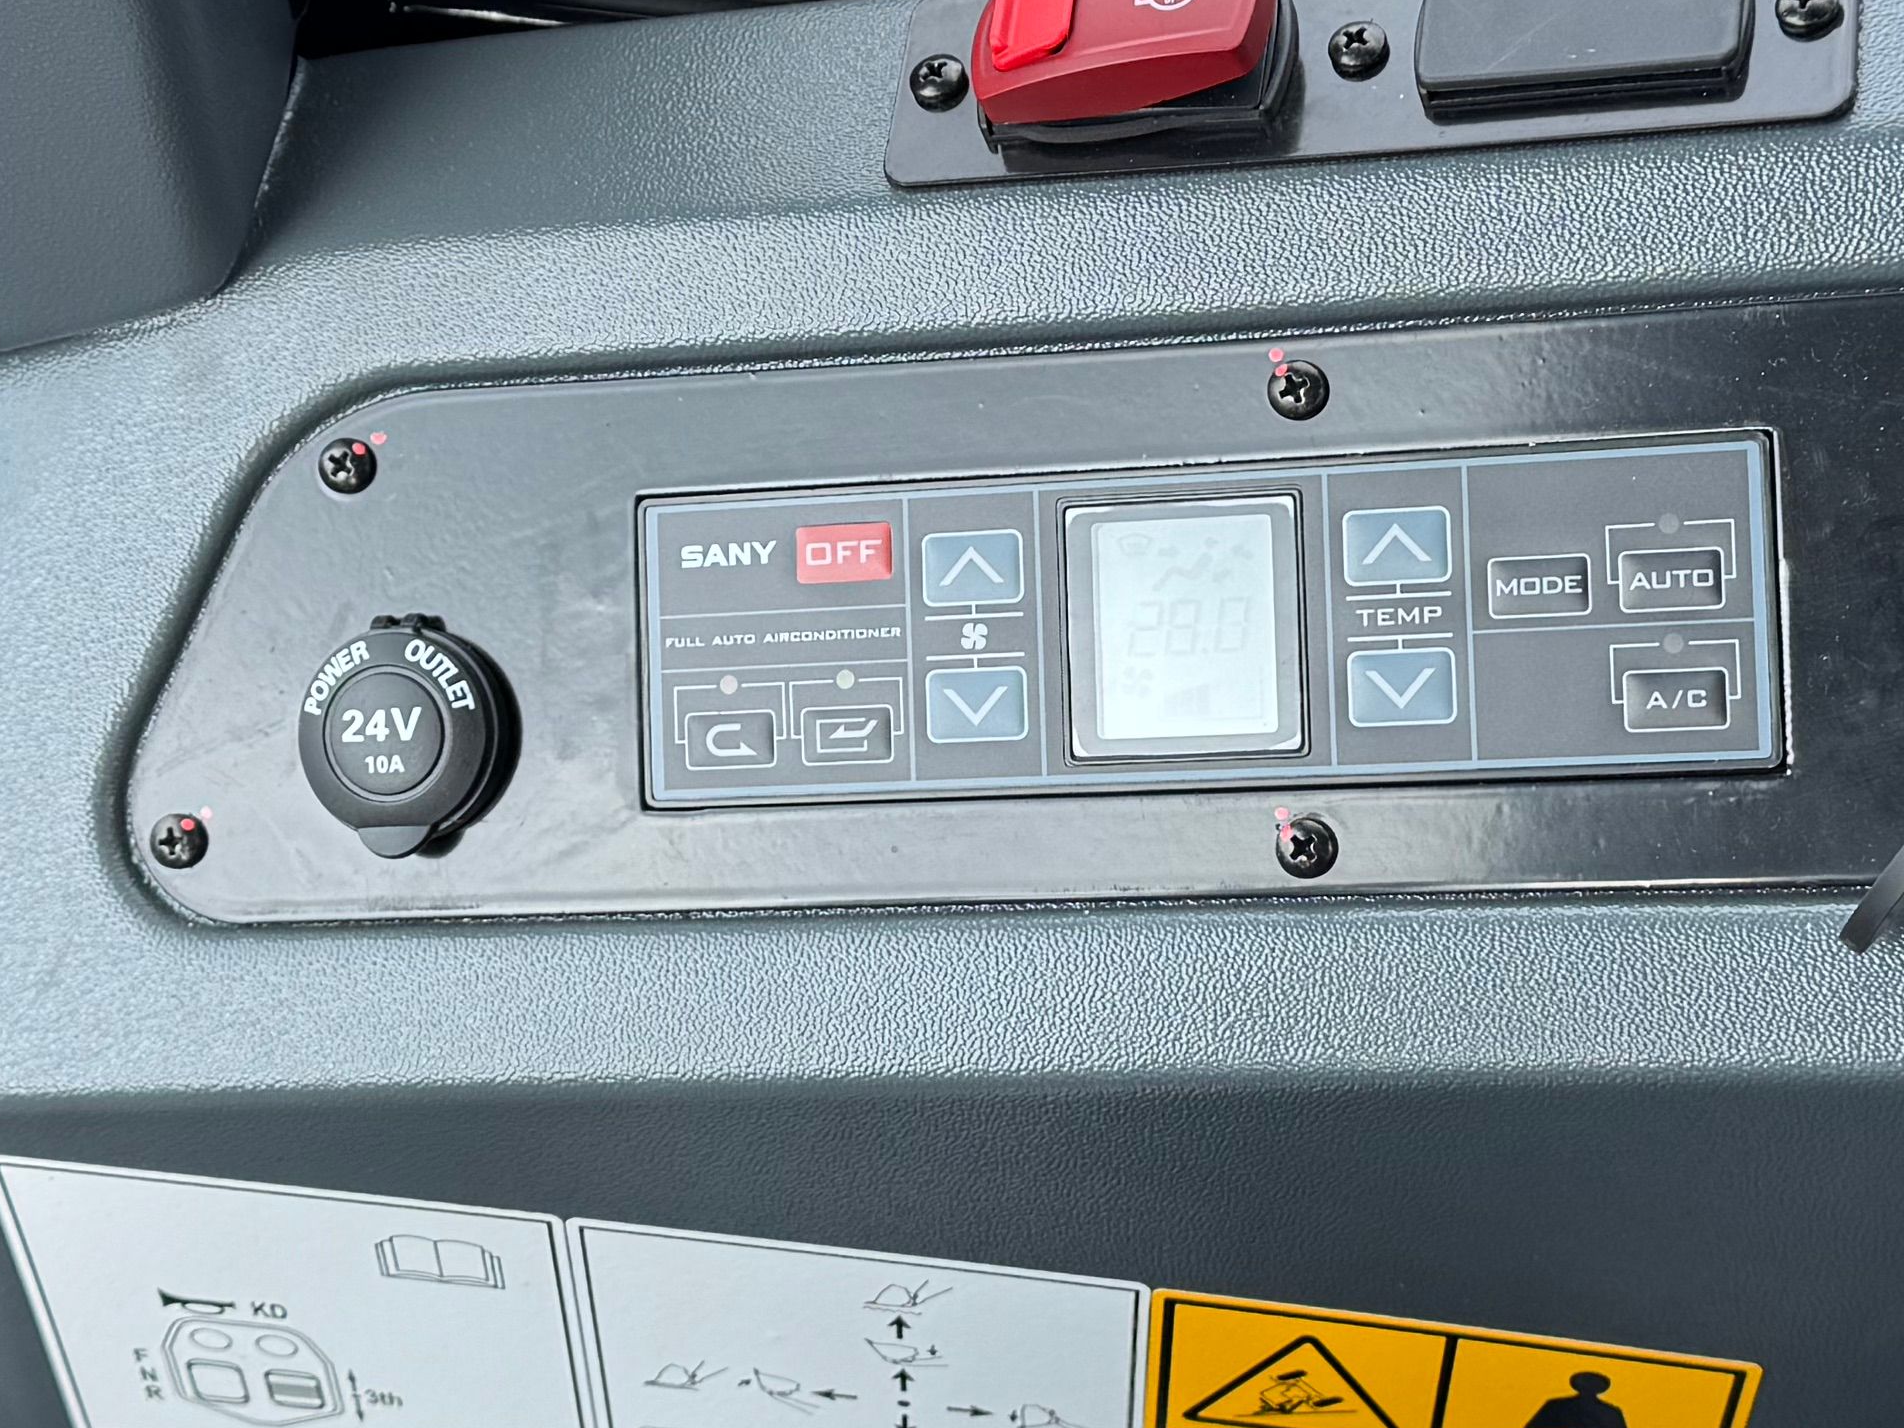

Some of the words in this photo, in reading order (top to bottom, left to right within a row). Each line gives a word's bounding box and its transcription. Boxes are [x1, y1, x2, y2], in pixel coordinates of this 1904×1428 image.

[680, 540, 777, 569] SANY
[804, 538, 883, 567] OFF
[1495, 574, 1583, 597] MODE
[1628, 568, 1715, 591] AUTO
[1355, 605, 1444, 628] TEMP
[665, 635, 705, 649] FULL
[711, 632, 757, 647] AUTO
[762, 626, 902, 645] AIRCONDITIONER
[303, 640, 371, 717] POWER
[404, 637, 476, 712] OUTLET
[1645, 688, 1708, 711] A/C
[341, 706, 423, 744] 24V
[364, 754, 406, 774] 10A
[250, 1300, 288, 1320] KD
[133, 1348, 149, 1362] F
[140, 1366, 157, 1382] N
[145, 1385, 164, 1400] R
